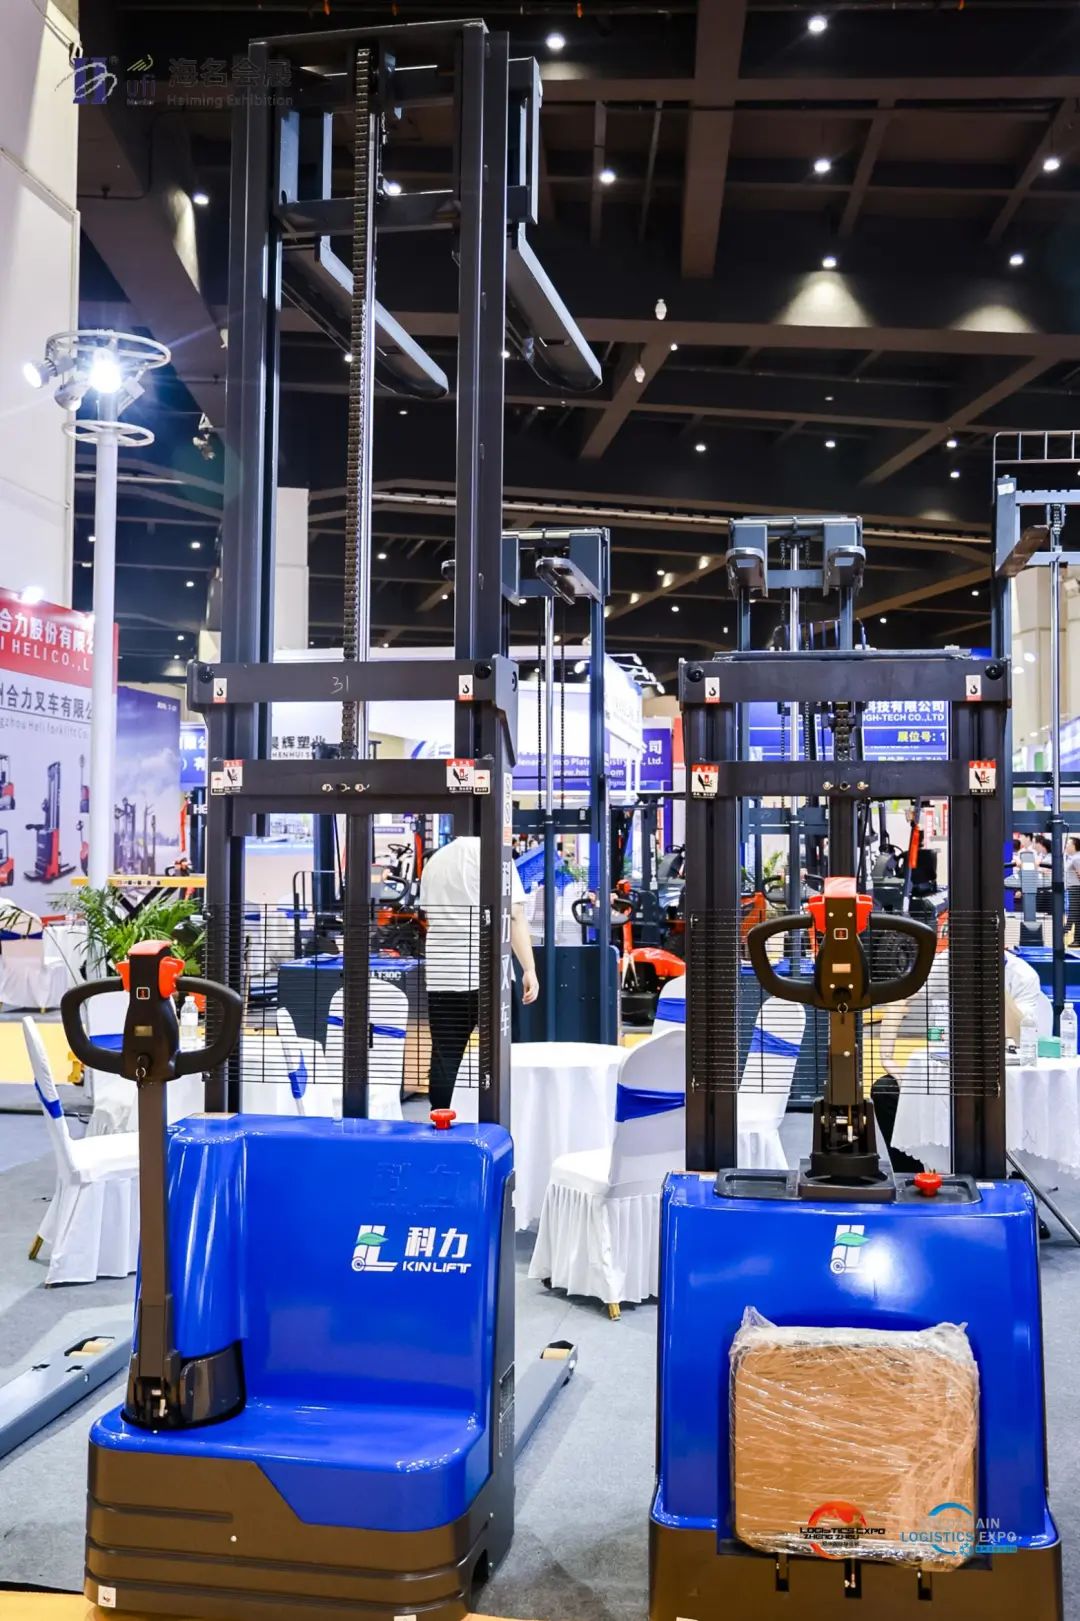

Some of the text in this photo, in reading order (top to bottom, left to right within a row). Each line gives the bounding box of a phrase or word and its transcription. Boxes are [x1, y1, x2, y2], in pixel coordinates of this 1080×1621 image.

[330, 674, 350, 695] 31
[404, 1226, 469, 1259] 科力
[402, 1260, 472, 1274] KINLIFT
